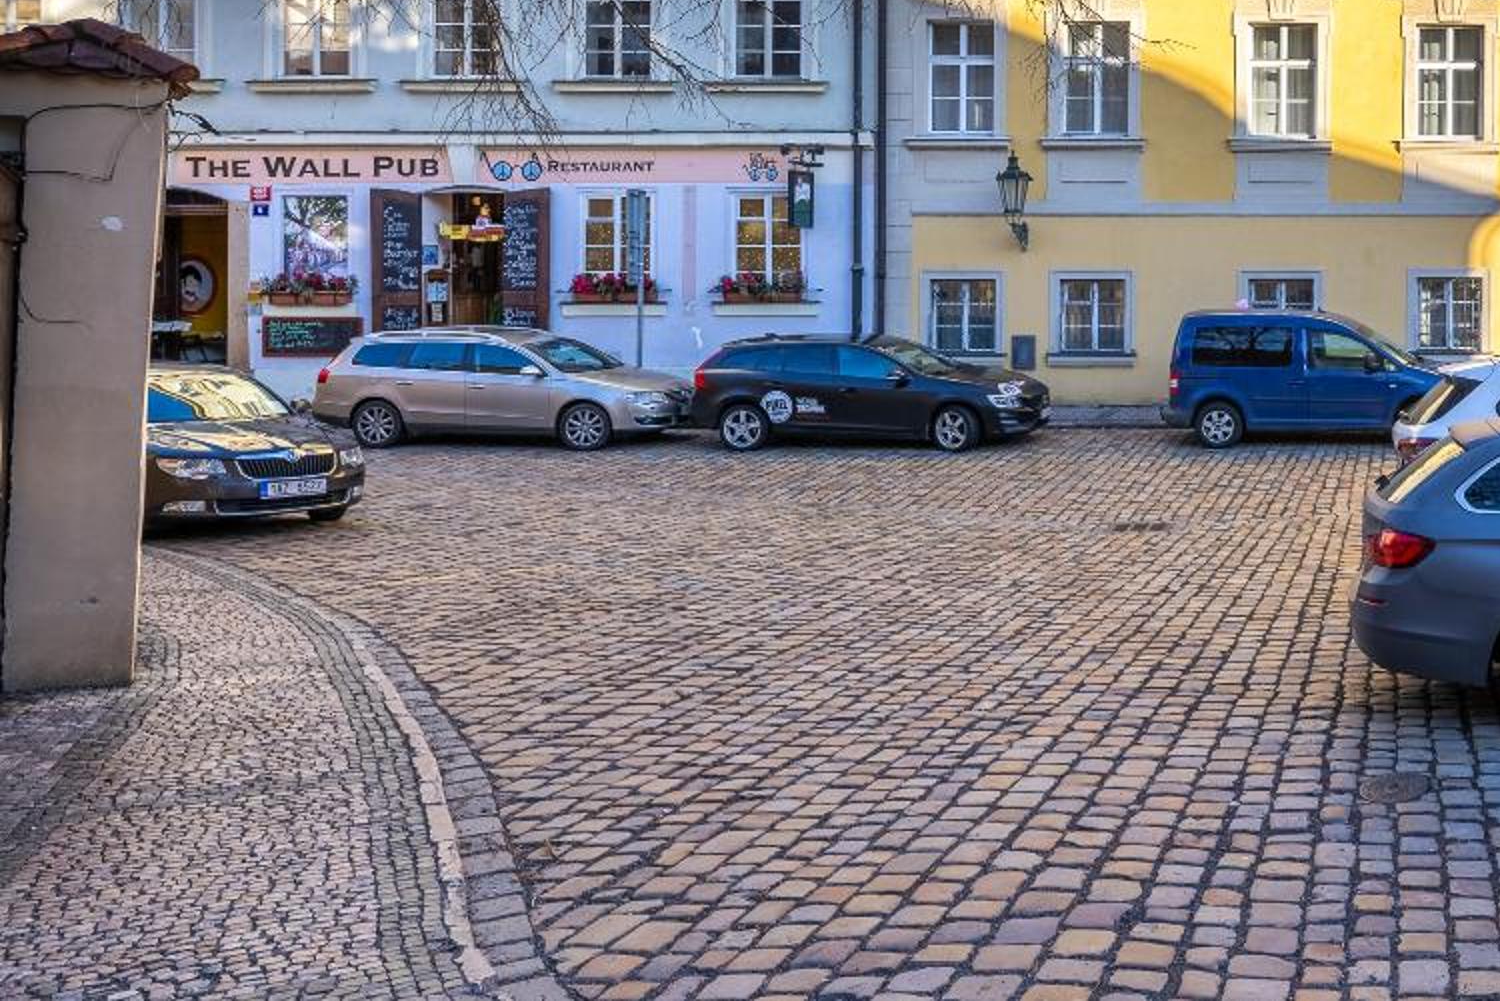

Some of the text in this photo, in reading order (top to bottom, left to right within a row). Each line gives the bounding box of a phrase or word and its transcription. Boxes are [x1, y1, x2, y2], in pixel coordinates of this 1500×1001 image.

[185, 156, 439, 178] THE WALL PUB
[547, 160, 655, 172] RESTAURANT
